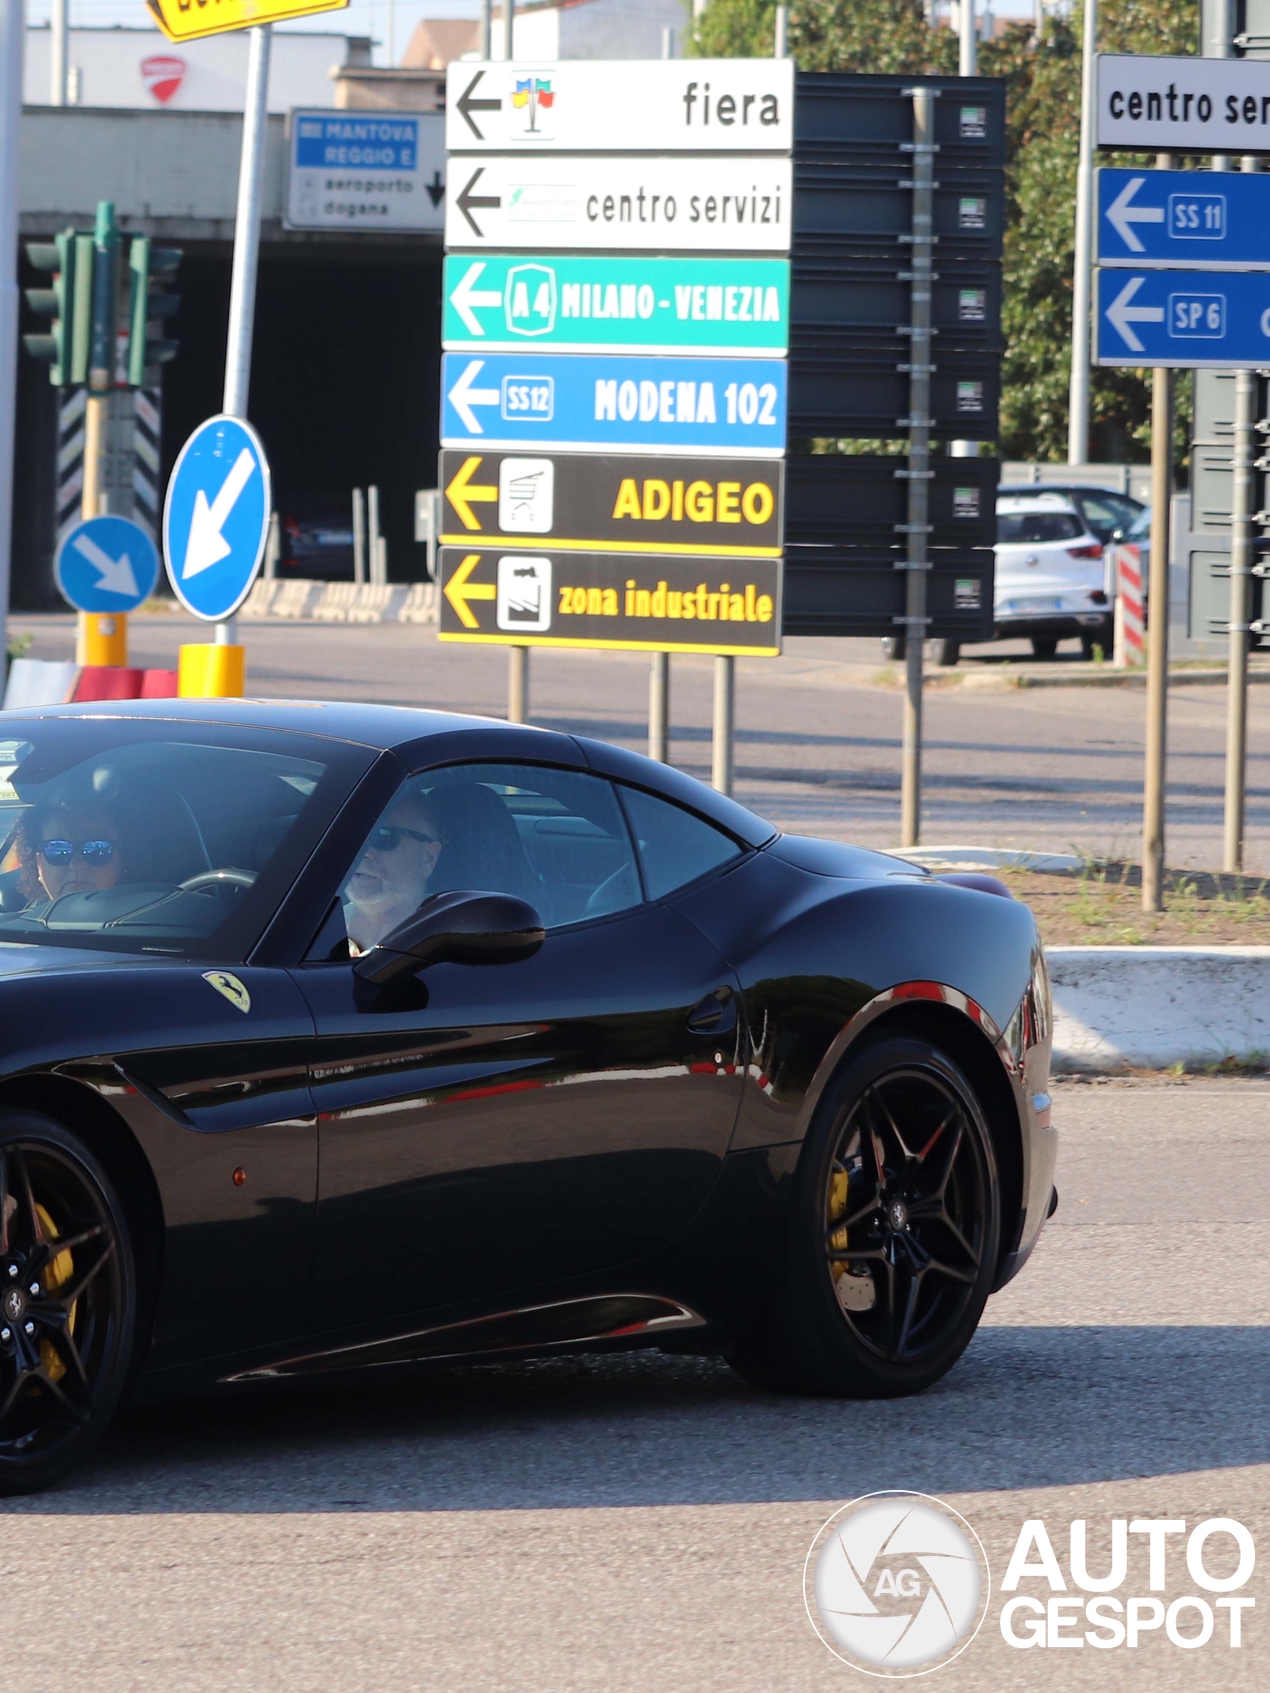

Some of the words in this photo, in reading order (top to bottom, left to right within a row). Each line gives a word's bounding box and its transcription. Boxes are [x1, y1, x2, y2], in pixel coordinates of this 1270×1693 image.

[683, 82, 780, 126] fiera
[1109, 84, 1212, 122] centro
[325, 124, 414, 141] MANTOVA
[324, 147, 395, 165] REGGIO
[325, 178, 413, 194] aeroporto
[586, 186, 677, 222] centro
[689, 185, 781, 224] servizi
[324, 202, 389, 218] dogana
[1175, 204, 1199, 229] SS
[1204, 205, 1221, 229] 11
[561, 283, 654, 319] MILANO
[674, 285, 780, 322] VENEZIA
[508, 386, 550, 412] SS12
[594, 379, 717, 423] MODENA
[724, 383, 777, 425] 102
[612, 478, 775, 525] ADIGEO
[558, 587, 618, 616] zona
[625, 579, 773, 623] industriale
